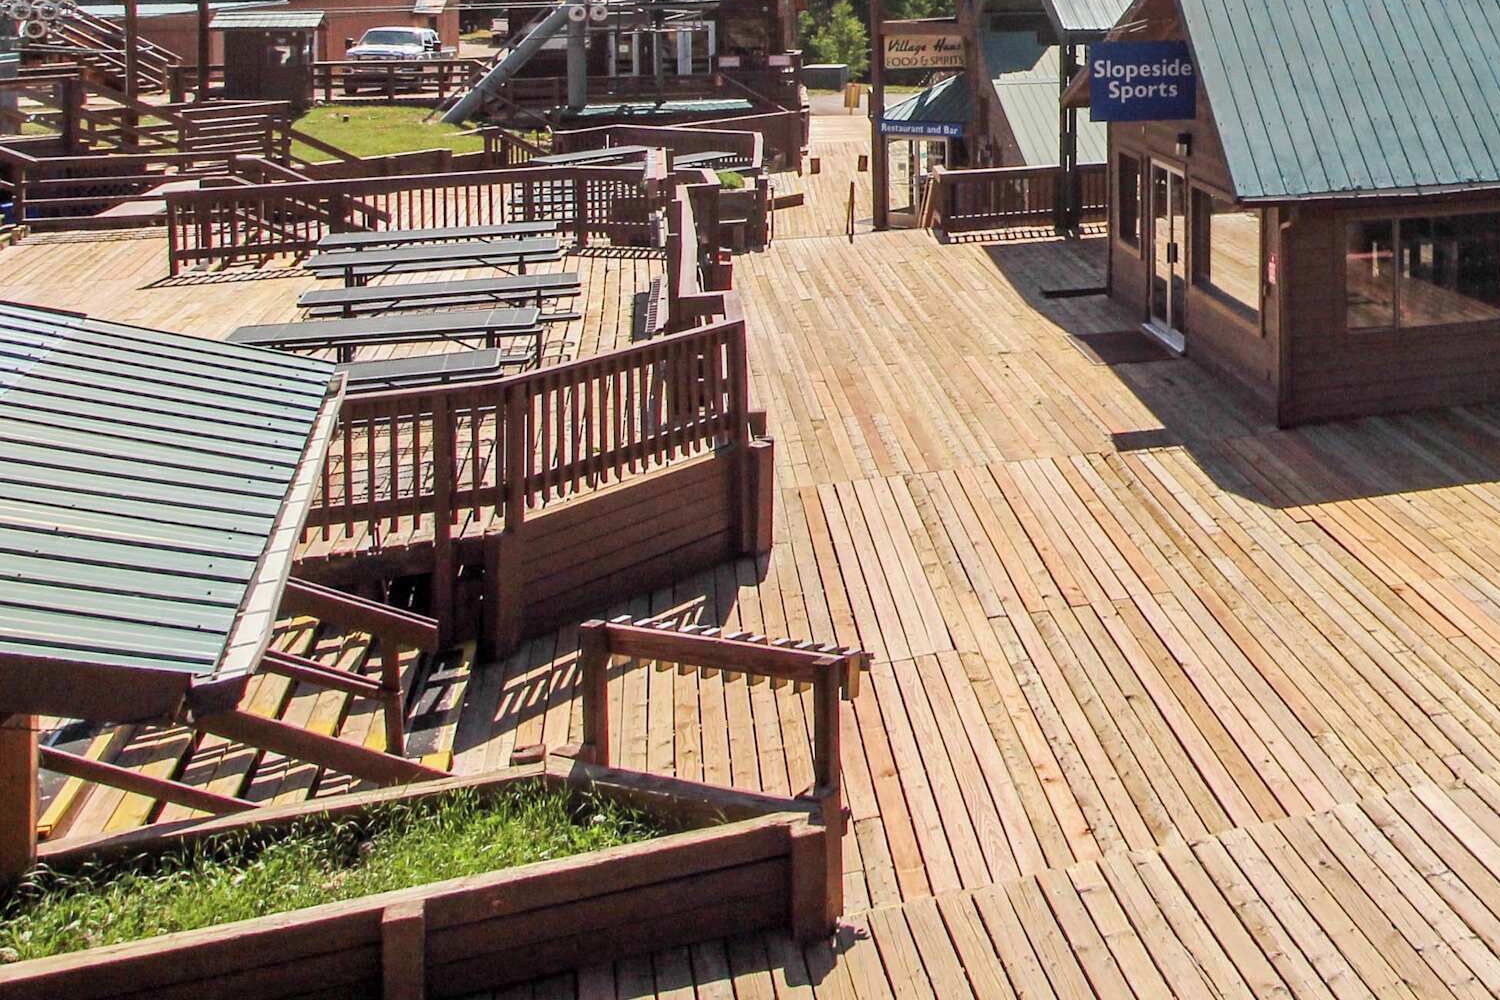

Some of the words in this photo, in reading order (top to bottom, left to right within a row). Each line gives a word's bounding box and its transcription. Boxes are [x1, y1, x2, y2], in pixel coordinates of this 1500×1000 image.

[888, 39, 927, 56] Village
[887, 56, 918, 67] FOOD
[930, 55, 966, 66] SPIRITS
[1093, 58, 1193, 83] Slopeside
[1108, 80, 1179, 104] Sports
[881, 122, 924, 134] Restaurant
[926, 125, 941, 134] and
[943, 125, 959, 135] Bar
